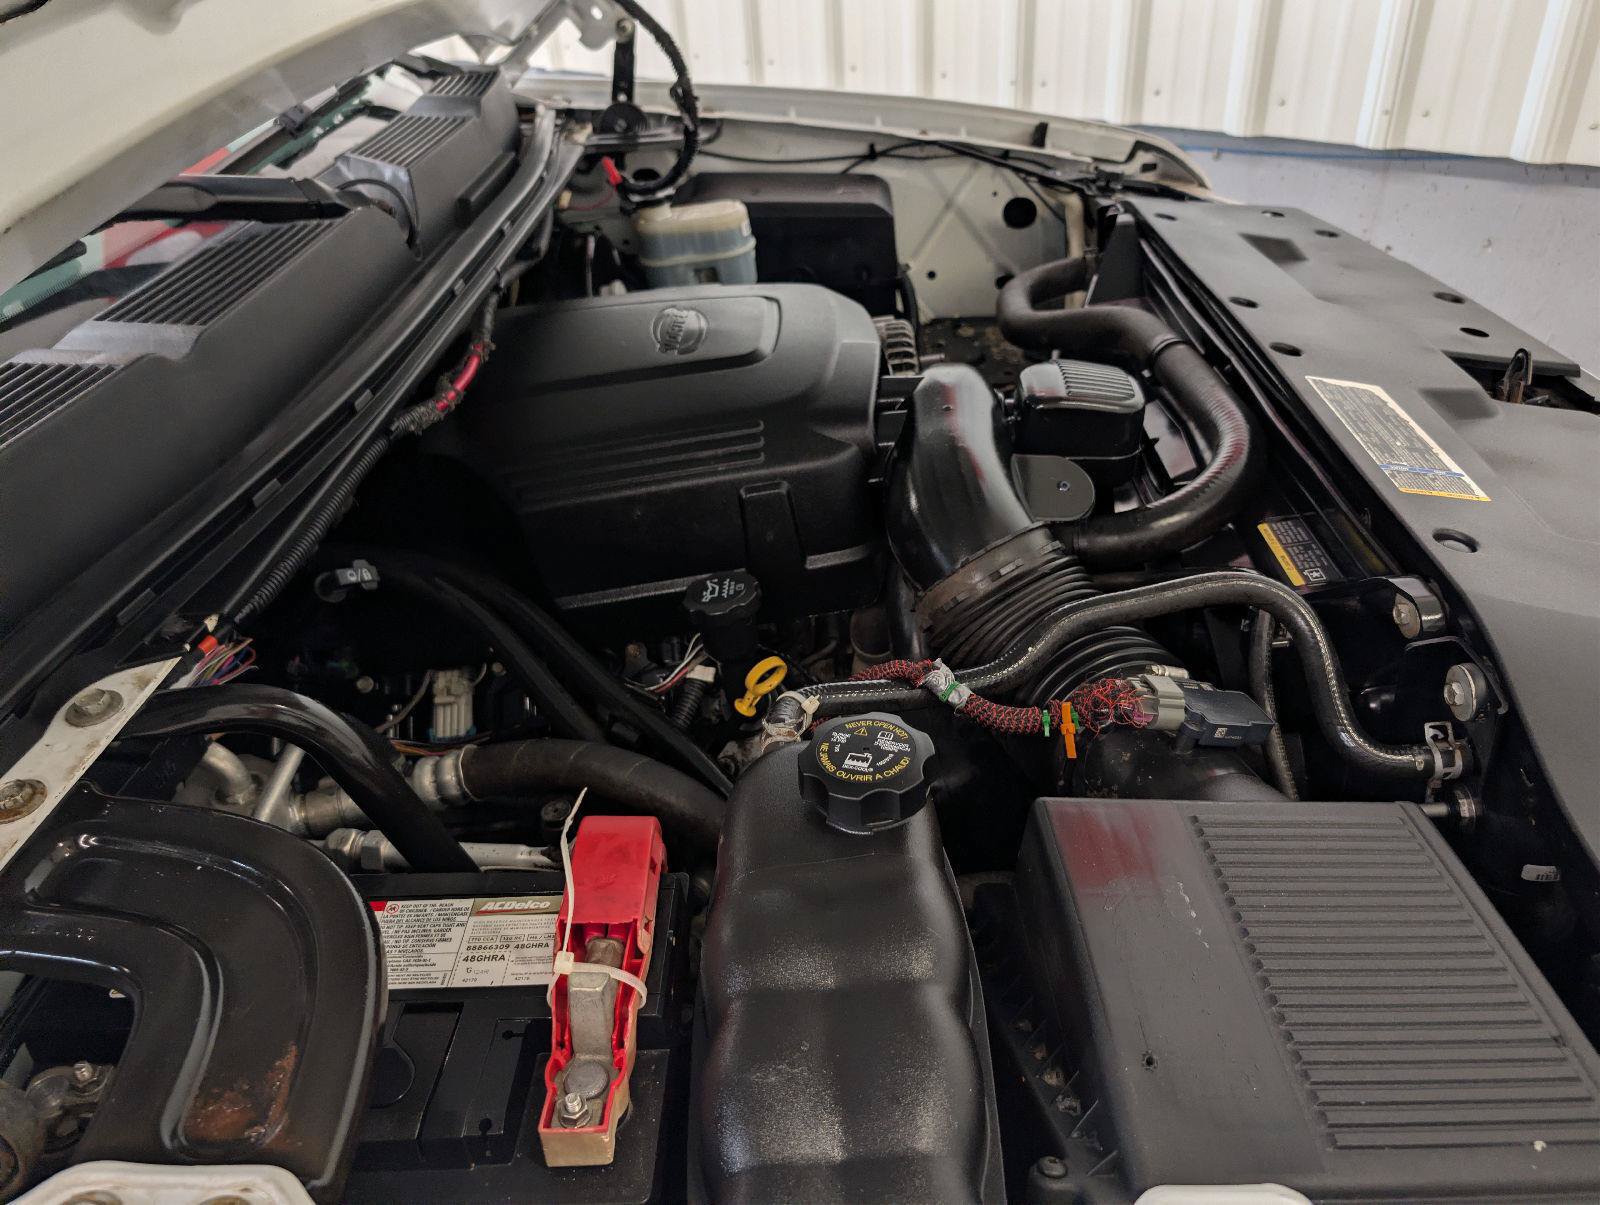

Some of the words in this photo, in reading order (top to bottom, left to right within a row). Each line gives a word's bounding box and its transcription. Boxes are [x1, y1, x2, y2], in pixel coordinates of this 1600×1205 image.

[845, 720, 872, 729] NEVER
[873, 720, 895, 731] OPEN
[819, 751, 837, 772] JAMAIS
[836, 770, 873, 782] OUVRIR
[480, 900, 551, 910] ACDelco
[514, 942, 550, 950] 48GHRA
[462, 954, 506, 962] 48GHRA
